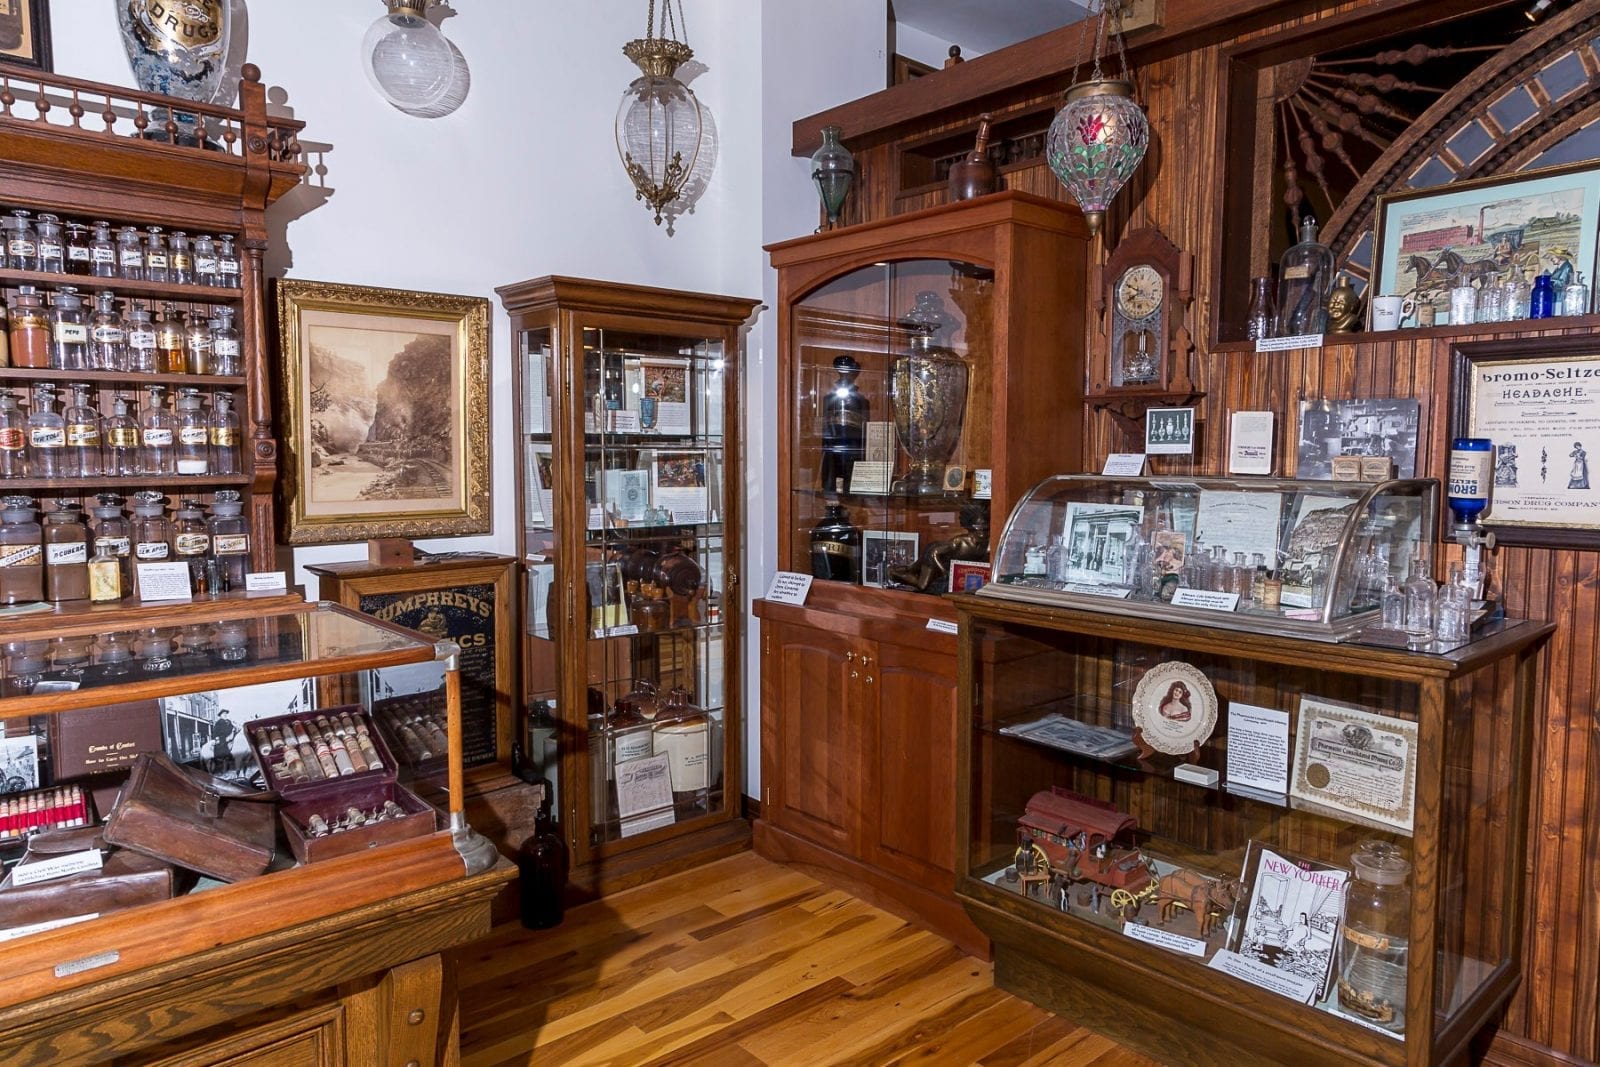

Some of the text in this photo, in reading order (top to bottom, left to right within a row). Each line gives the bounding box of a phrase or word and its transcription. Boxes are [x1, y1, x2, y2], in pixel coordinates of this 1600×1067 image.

[149, 4, 219, 38] DRUGS
[1502, 386, 1587, 399] HEADACHE.
[1264, 859, 1341, 891] NEW YORKER
[1297, 861, 1311, 870] THE
